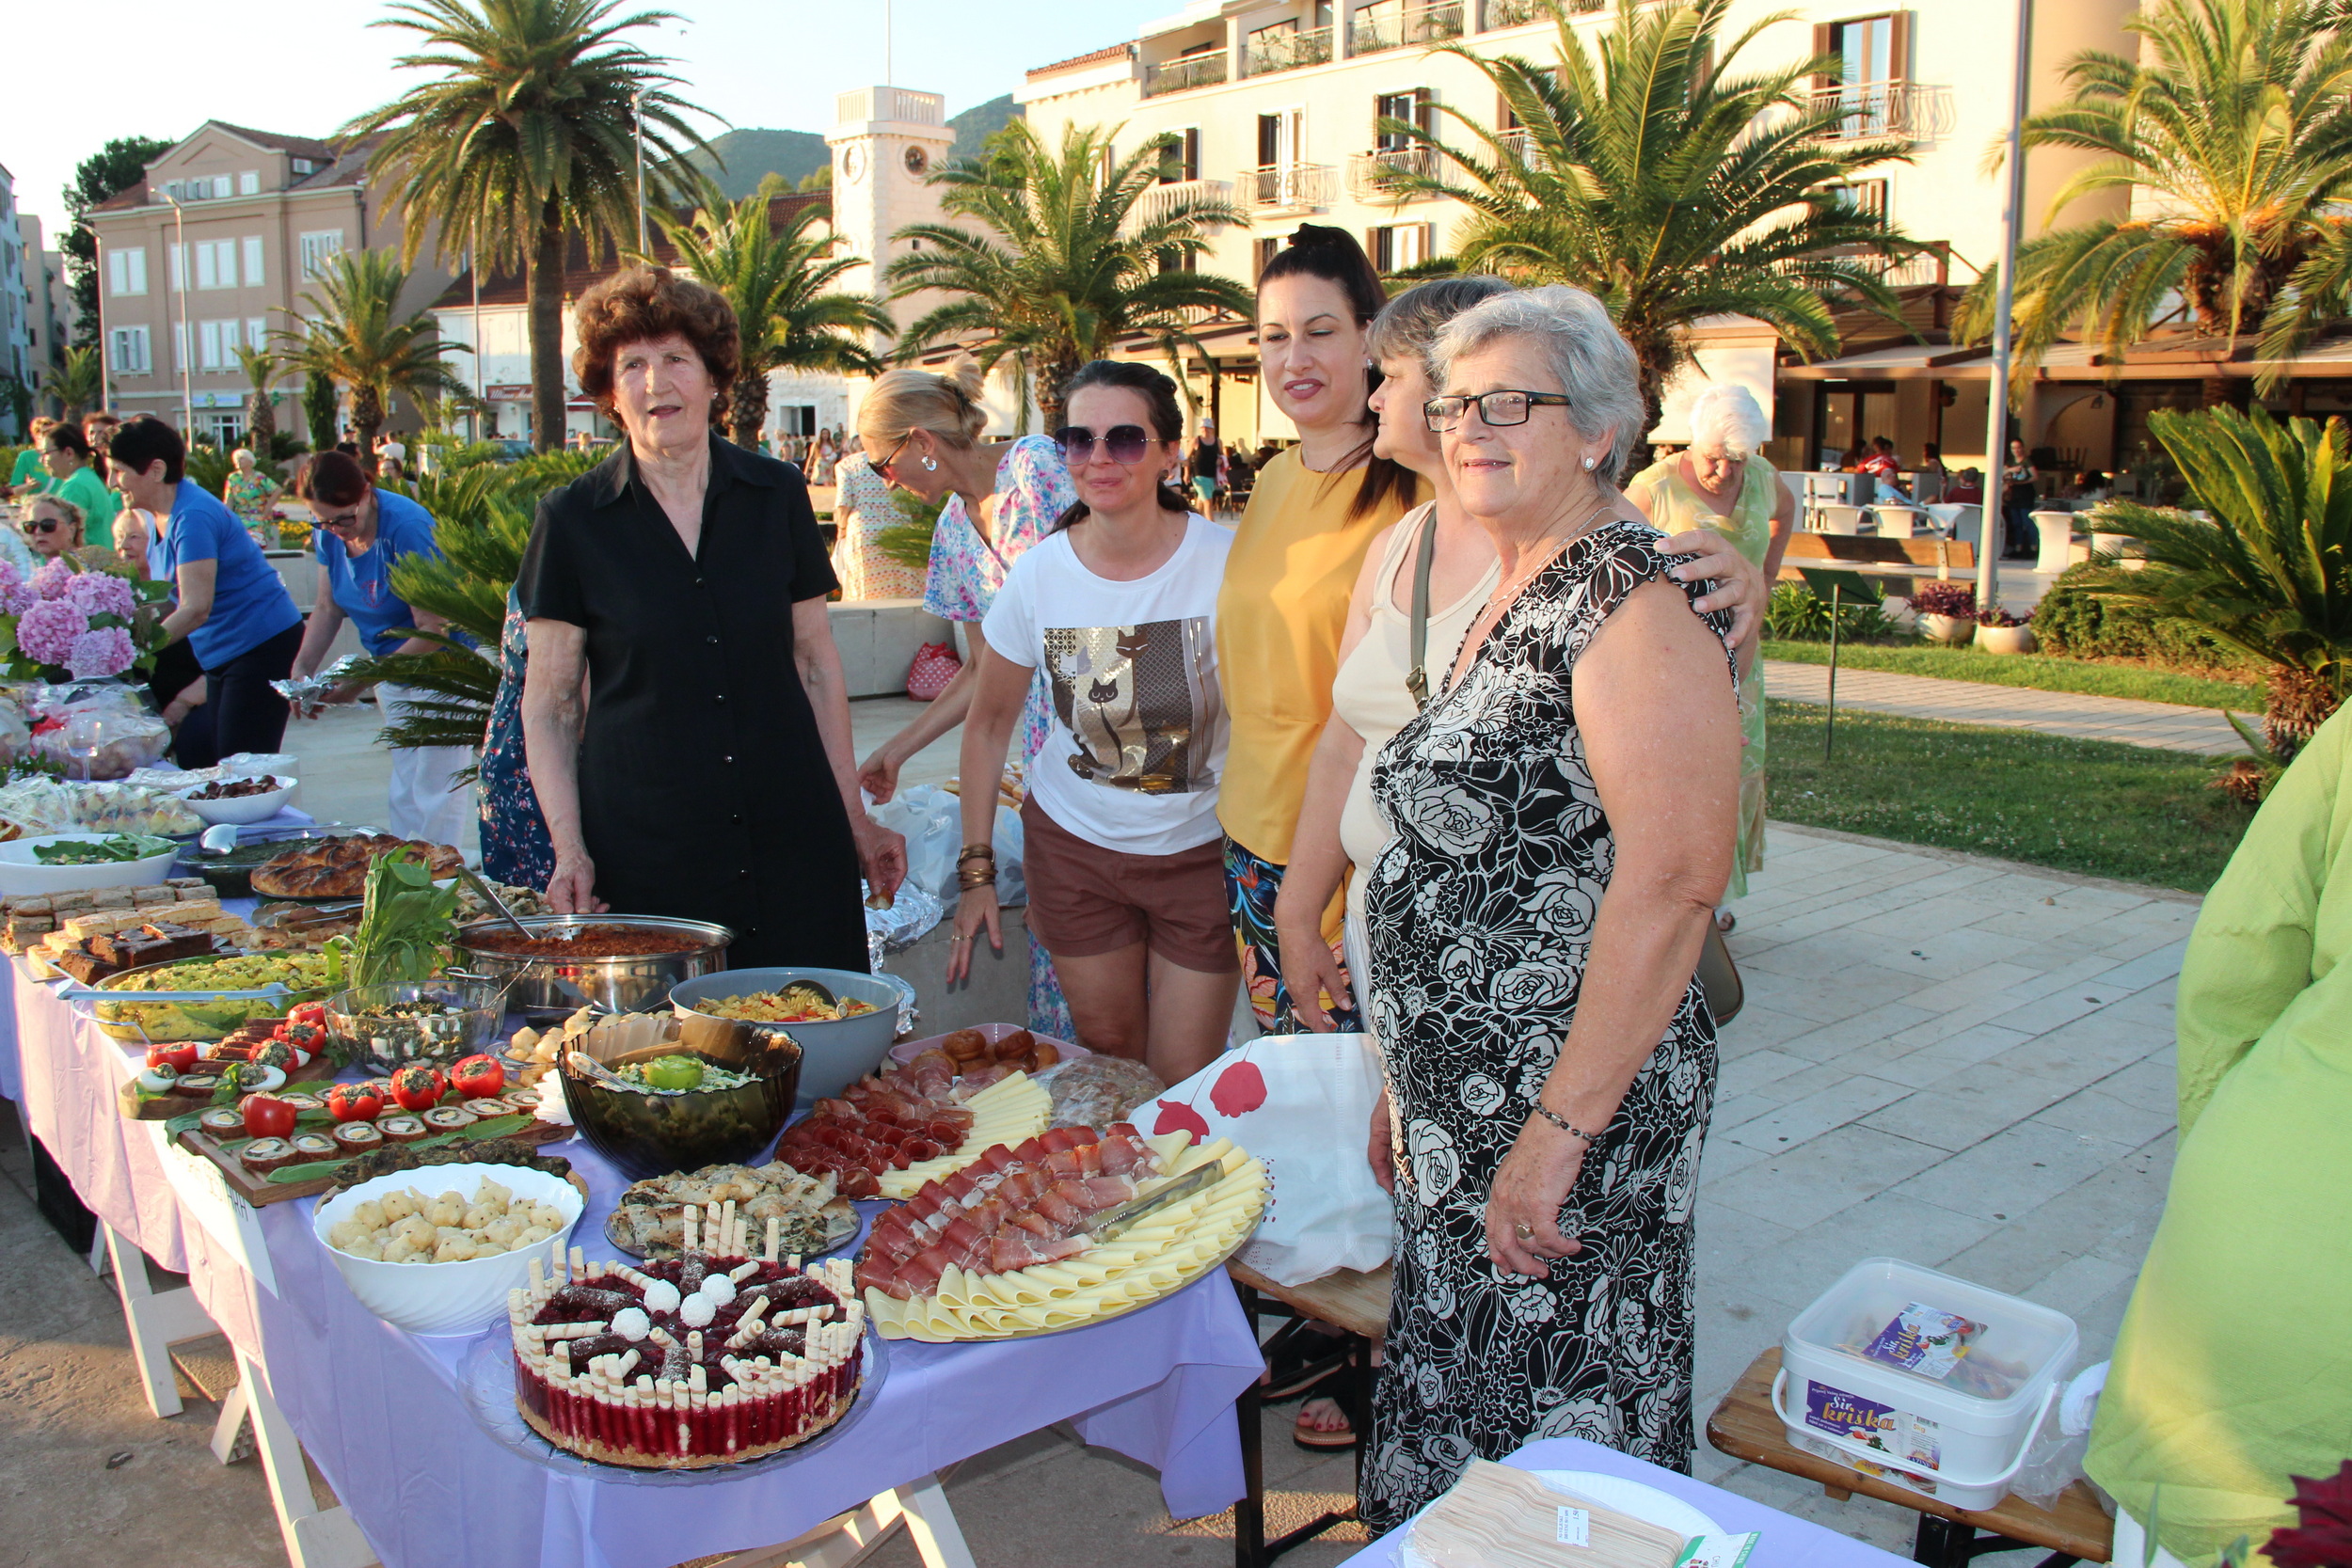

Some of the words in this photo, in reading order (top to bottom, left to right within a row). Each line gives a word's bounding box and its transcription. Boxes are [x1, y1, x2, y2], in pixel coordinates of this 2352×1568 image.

[1883, 1340, 1898, 1353] Sir
[1889, 1323, 1920, 1360] kriška
[1830, 1396, 1852, 1410] Sir
[1822, 1402, 1897, 1431] kriška
